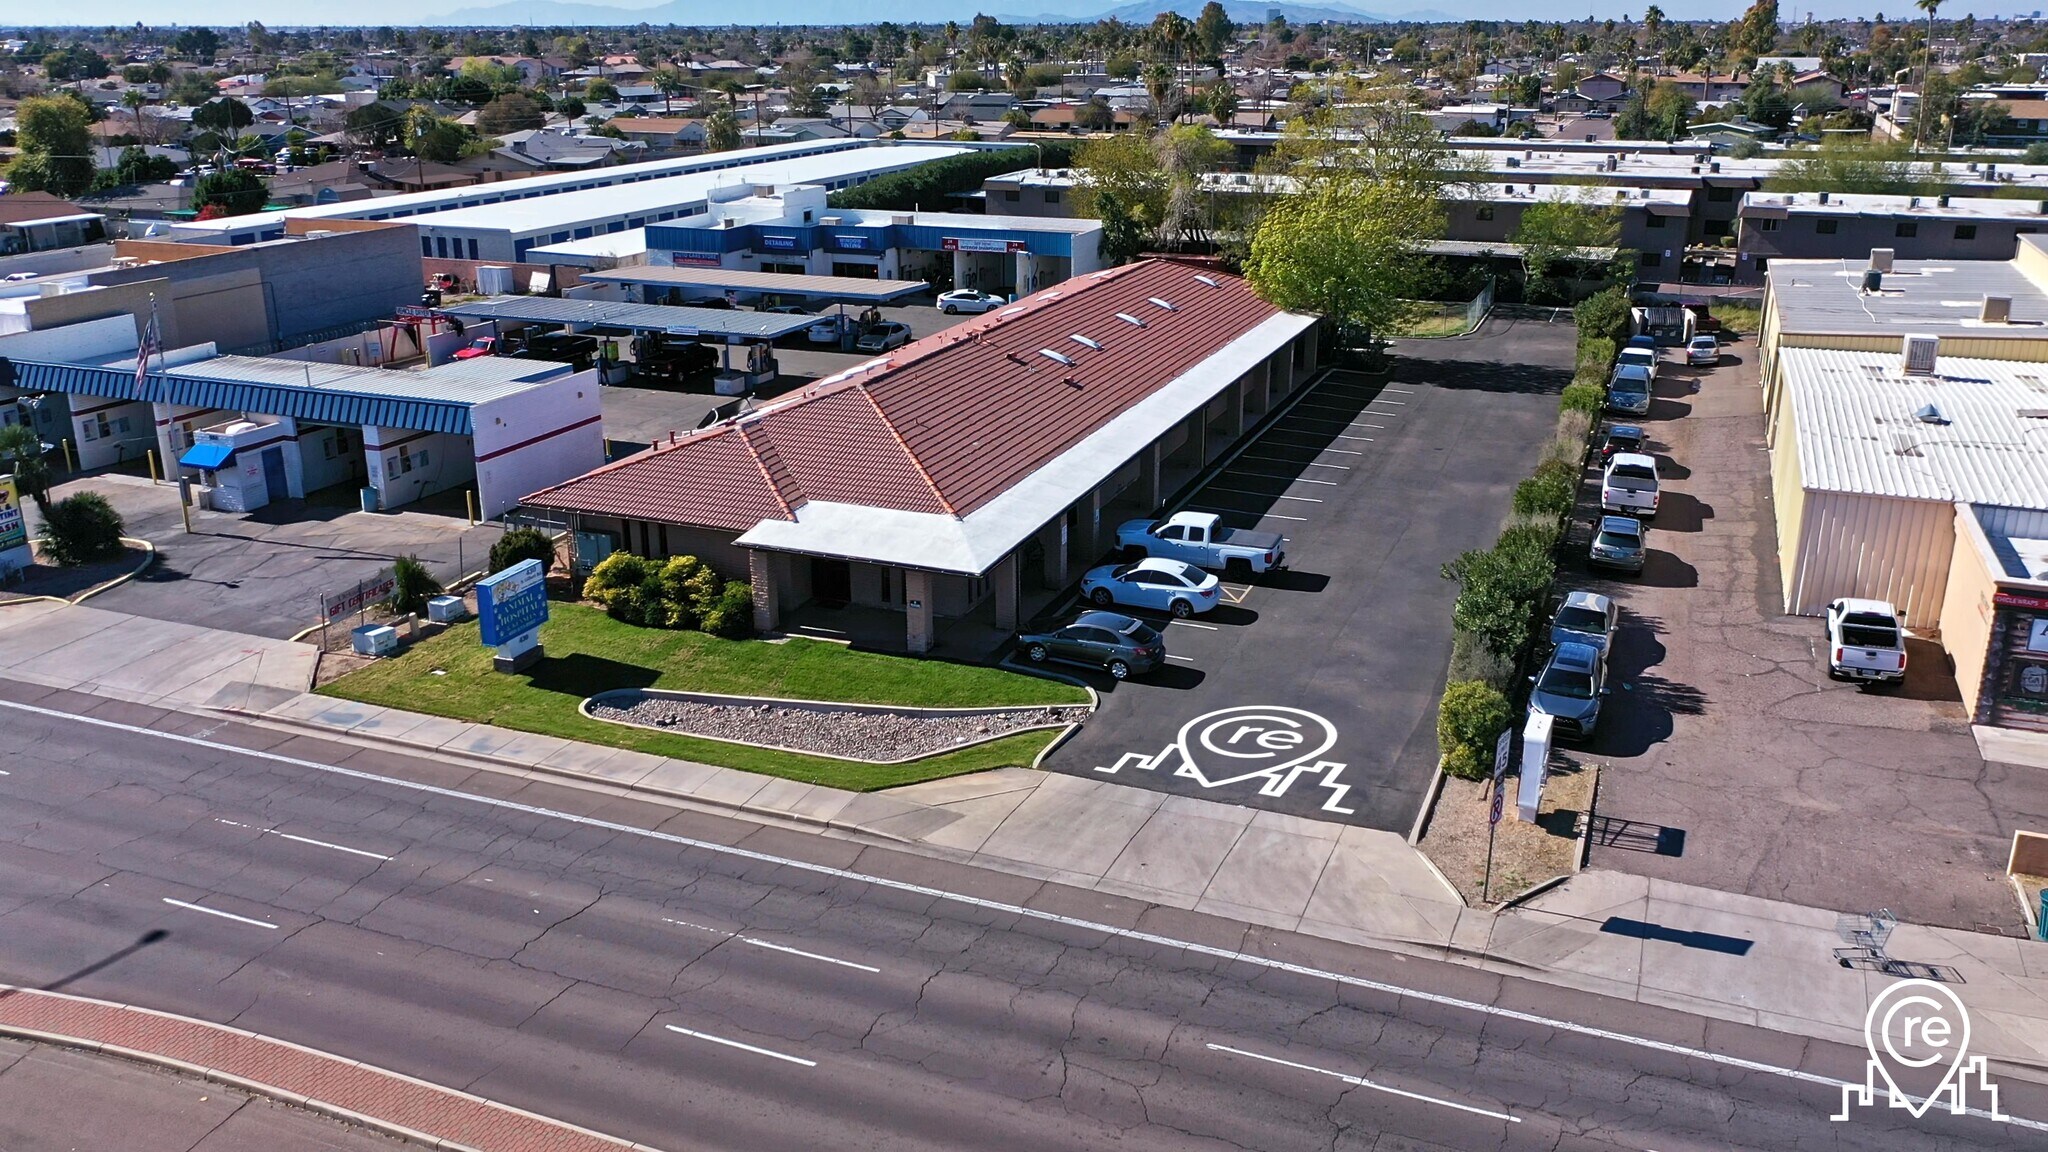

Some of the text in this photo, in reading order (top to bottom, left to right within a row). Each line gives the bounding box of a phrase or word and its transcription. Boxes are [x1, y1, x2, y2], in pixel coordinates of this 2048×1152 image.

[764, 239, 794, 247] DETAILING
[329, 600, 346, 617] GIFT
[348, 578, 395, 608] CERTIFICATES
[504, 593, 534, 613] ANIMAL
[2017, 598, 2039, 607] WRAPS
[500, 602, 538, 626] HOSPITAL
[1498, 733, 1510, 746] SPEED
[1495, 751, 1508, 772] 45
